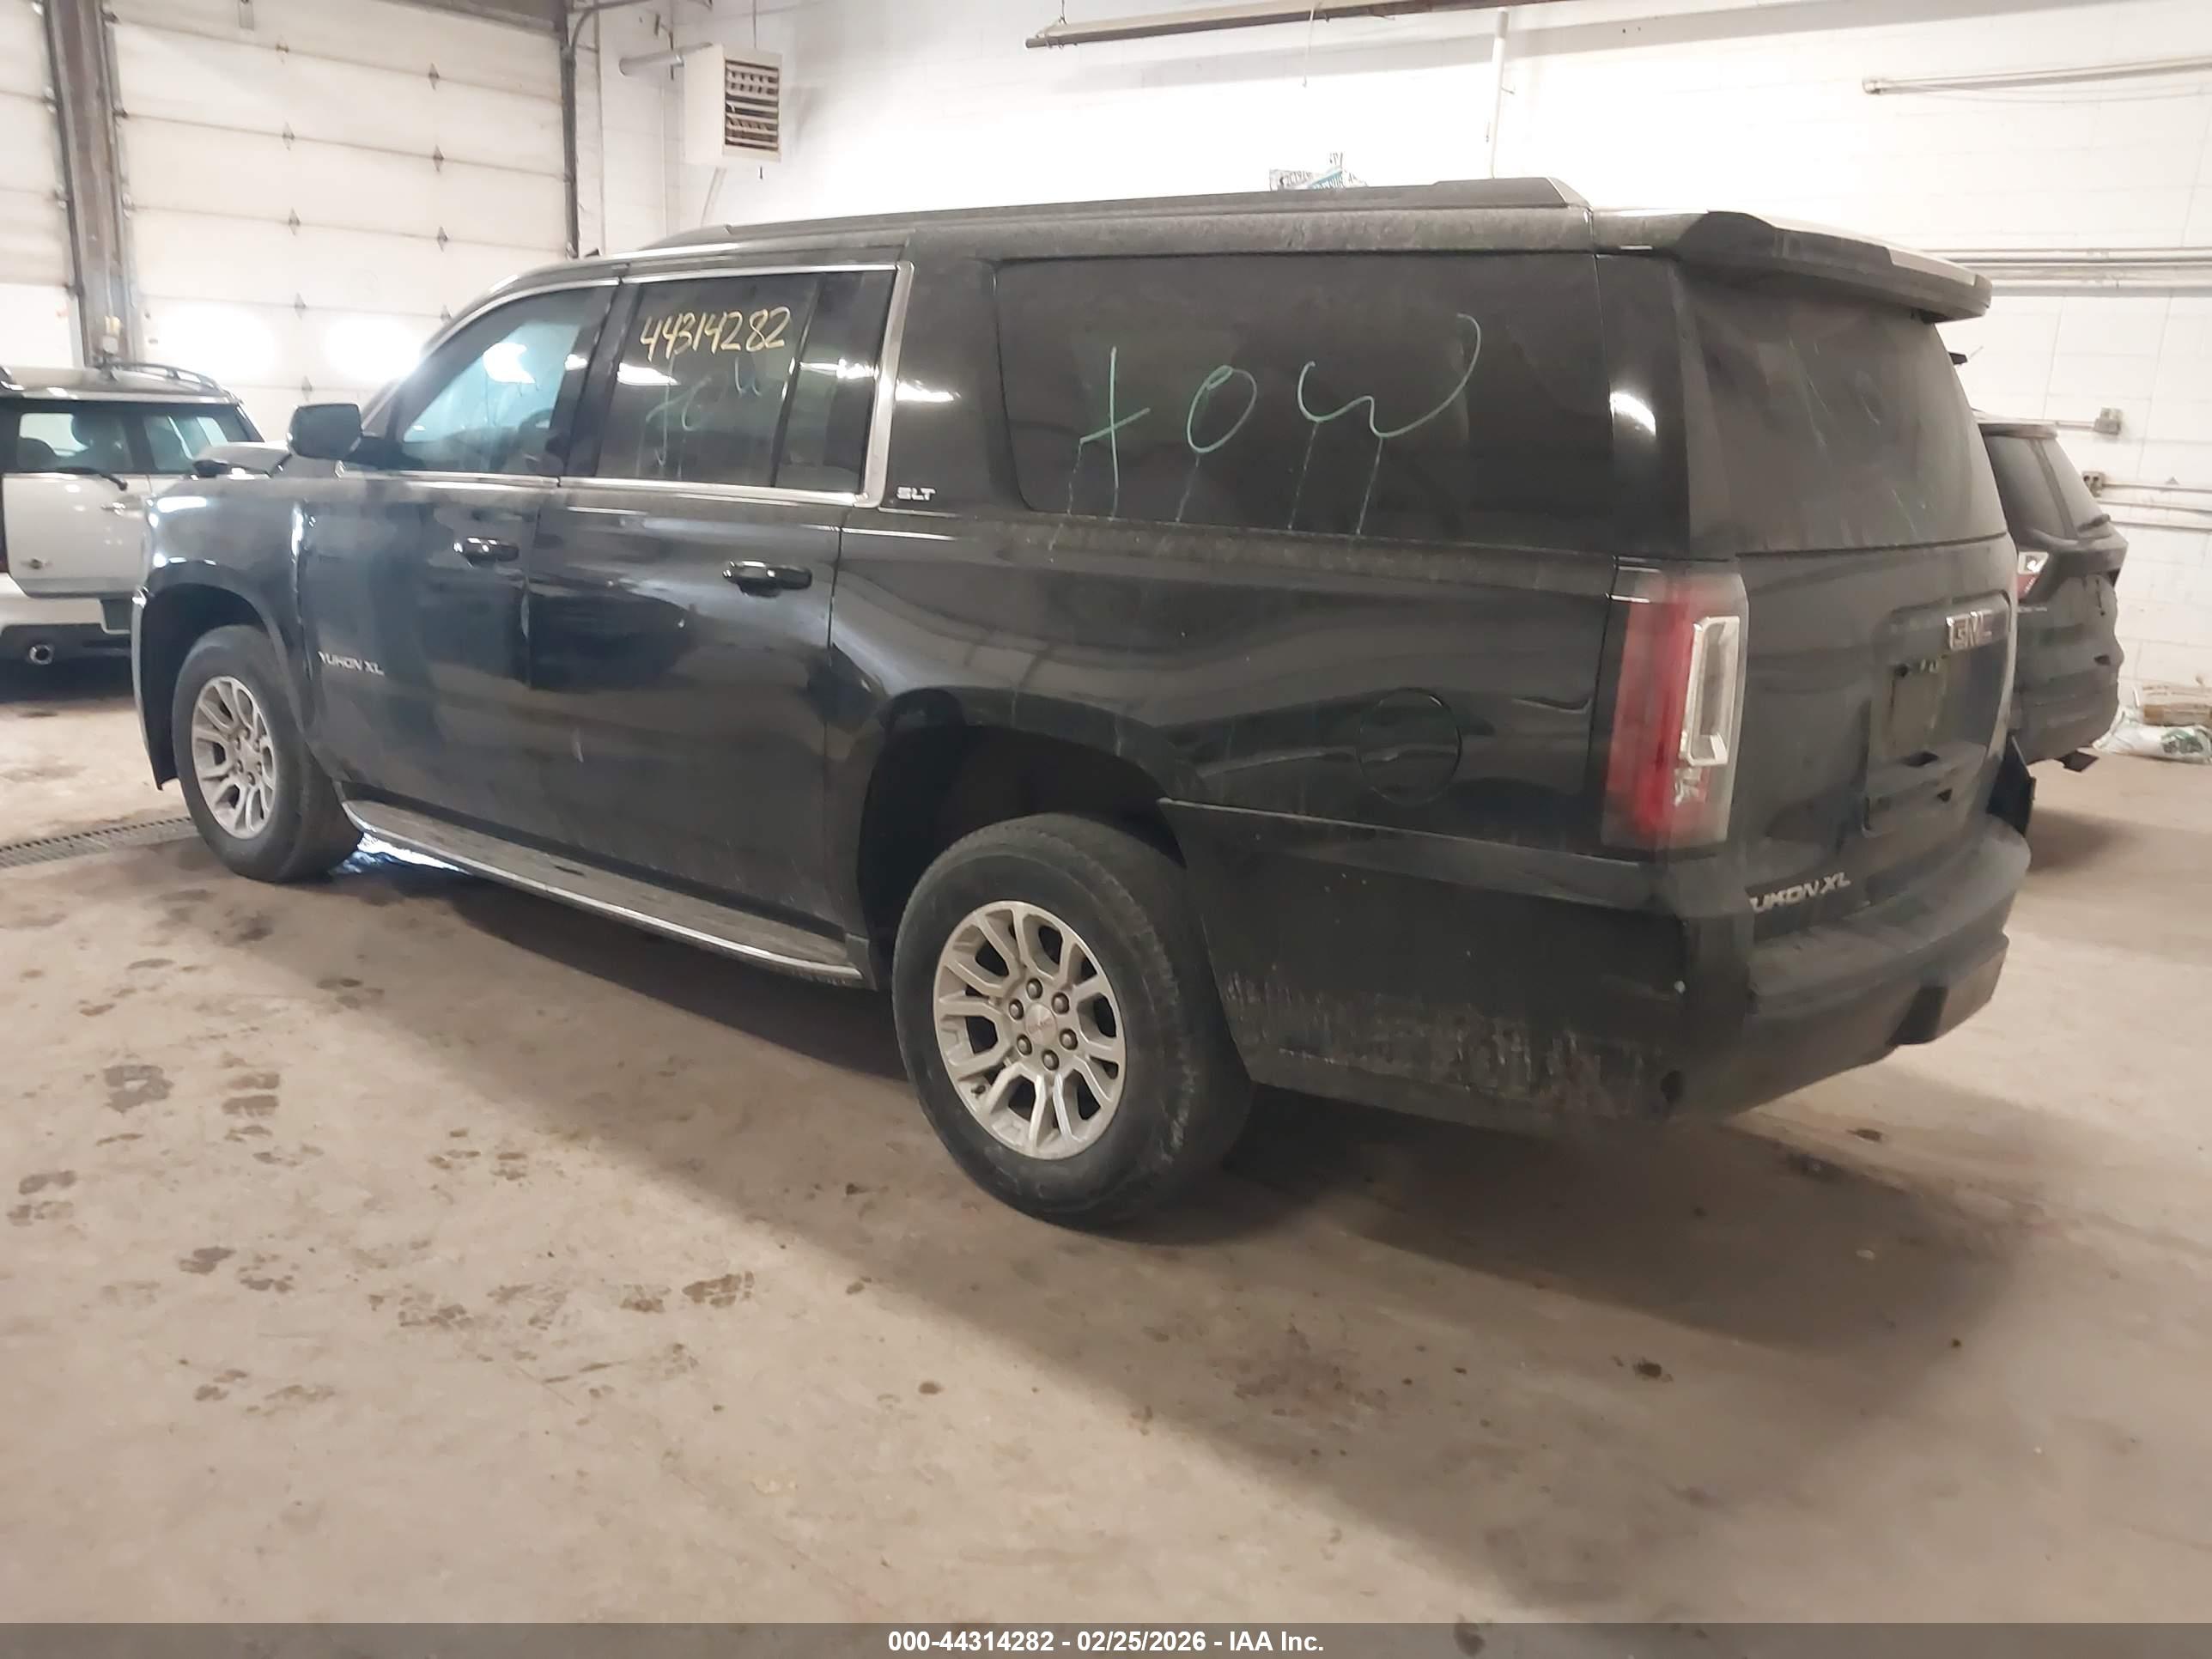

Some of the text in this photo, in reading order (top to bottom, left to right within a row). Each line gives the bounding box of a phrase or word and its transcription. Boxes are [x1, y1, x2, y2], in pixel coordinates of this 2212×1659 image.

[639, 306, 791, 362] 44314282
[1079, 313, 1481, 489] tow
[896, 487, 936, 501] SLT
[1946, 611, 1993, 650] GMC
[1749, 872, 1851, 914] UKON XL
